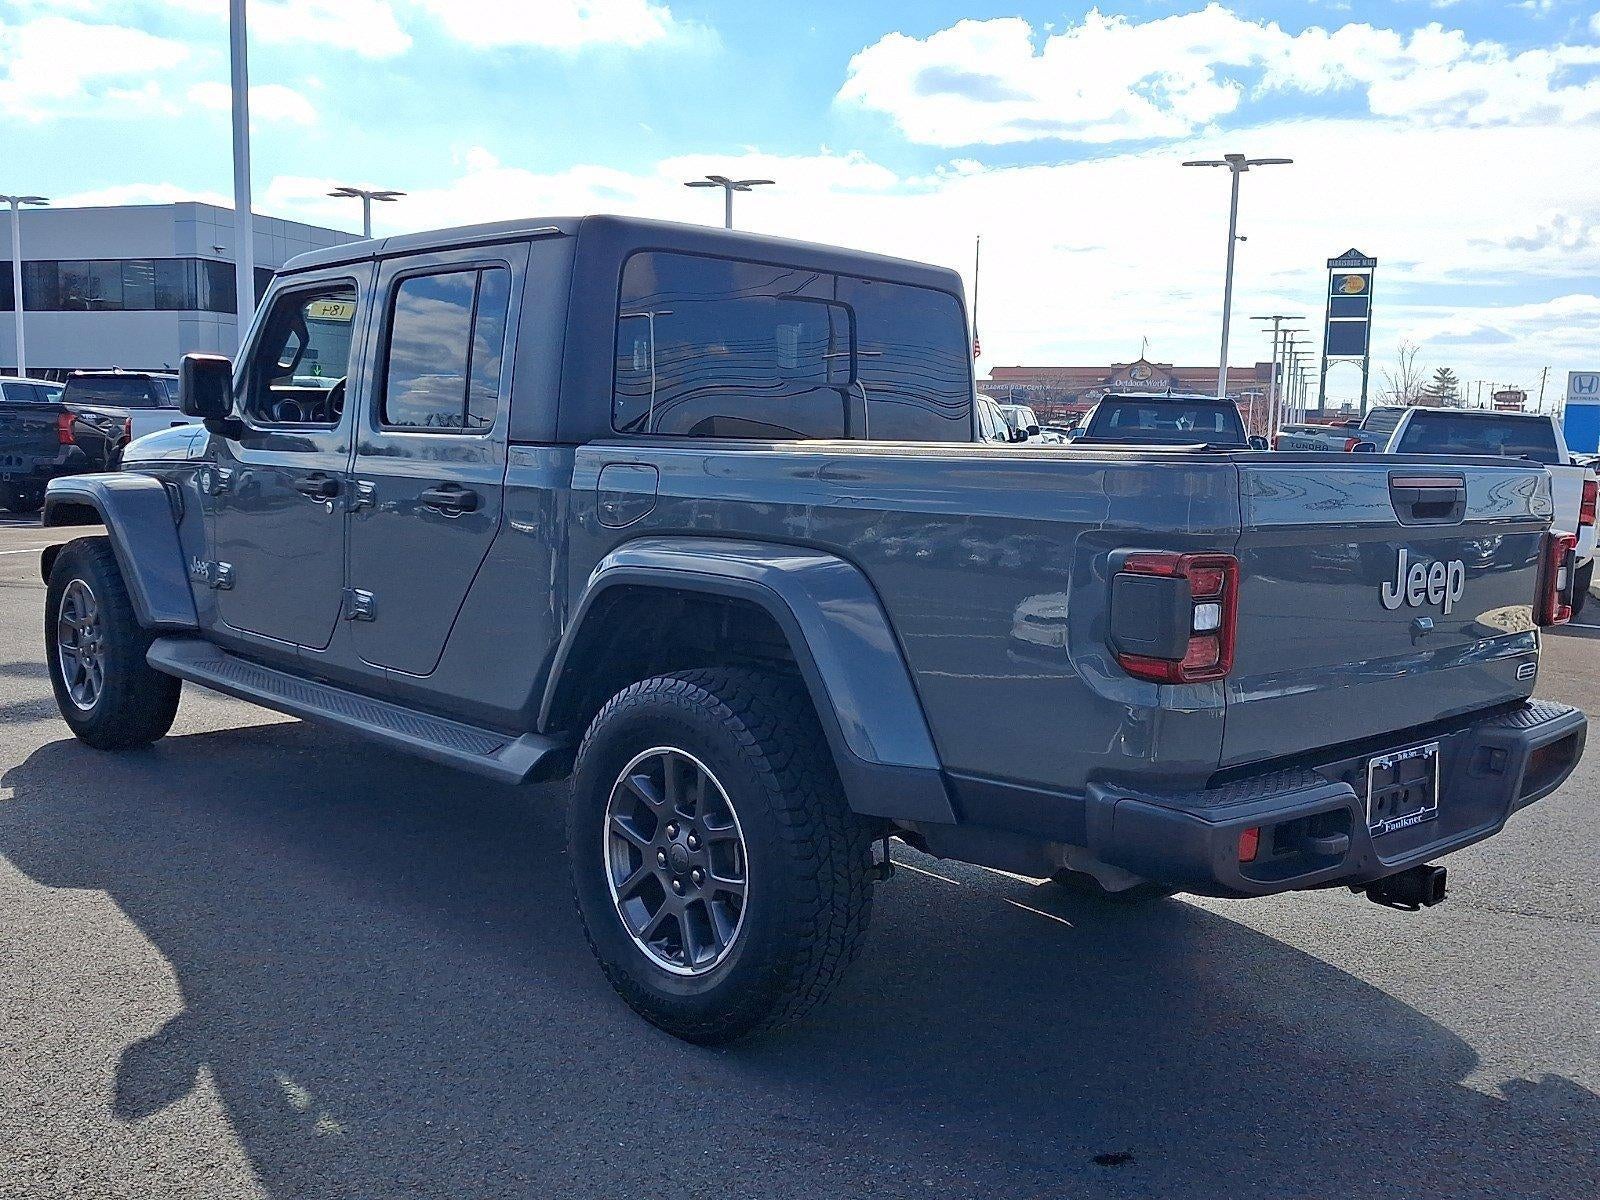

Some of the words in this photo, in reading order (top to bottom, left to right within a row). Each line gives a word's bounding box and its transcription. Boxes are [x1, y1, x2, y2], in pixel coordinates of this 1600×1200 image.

[1115, 379, 1144, 387] Outdoor
[1146, 379, 1167, 387] World
[1290, 442, 1329, 452] TUNDRA
[190, 555, 210, 580] Jeep
[1381, 548, 1465, 615] Jeep
[1385, 814, 1423, 832] Faulkner
